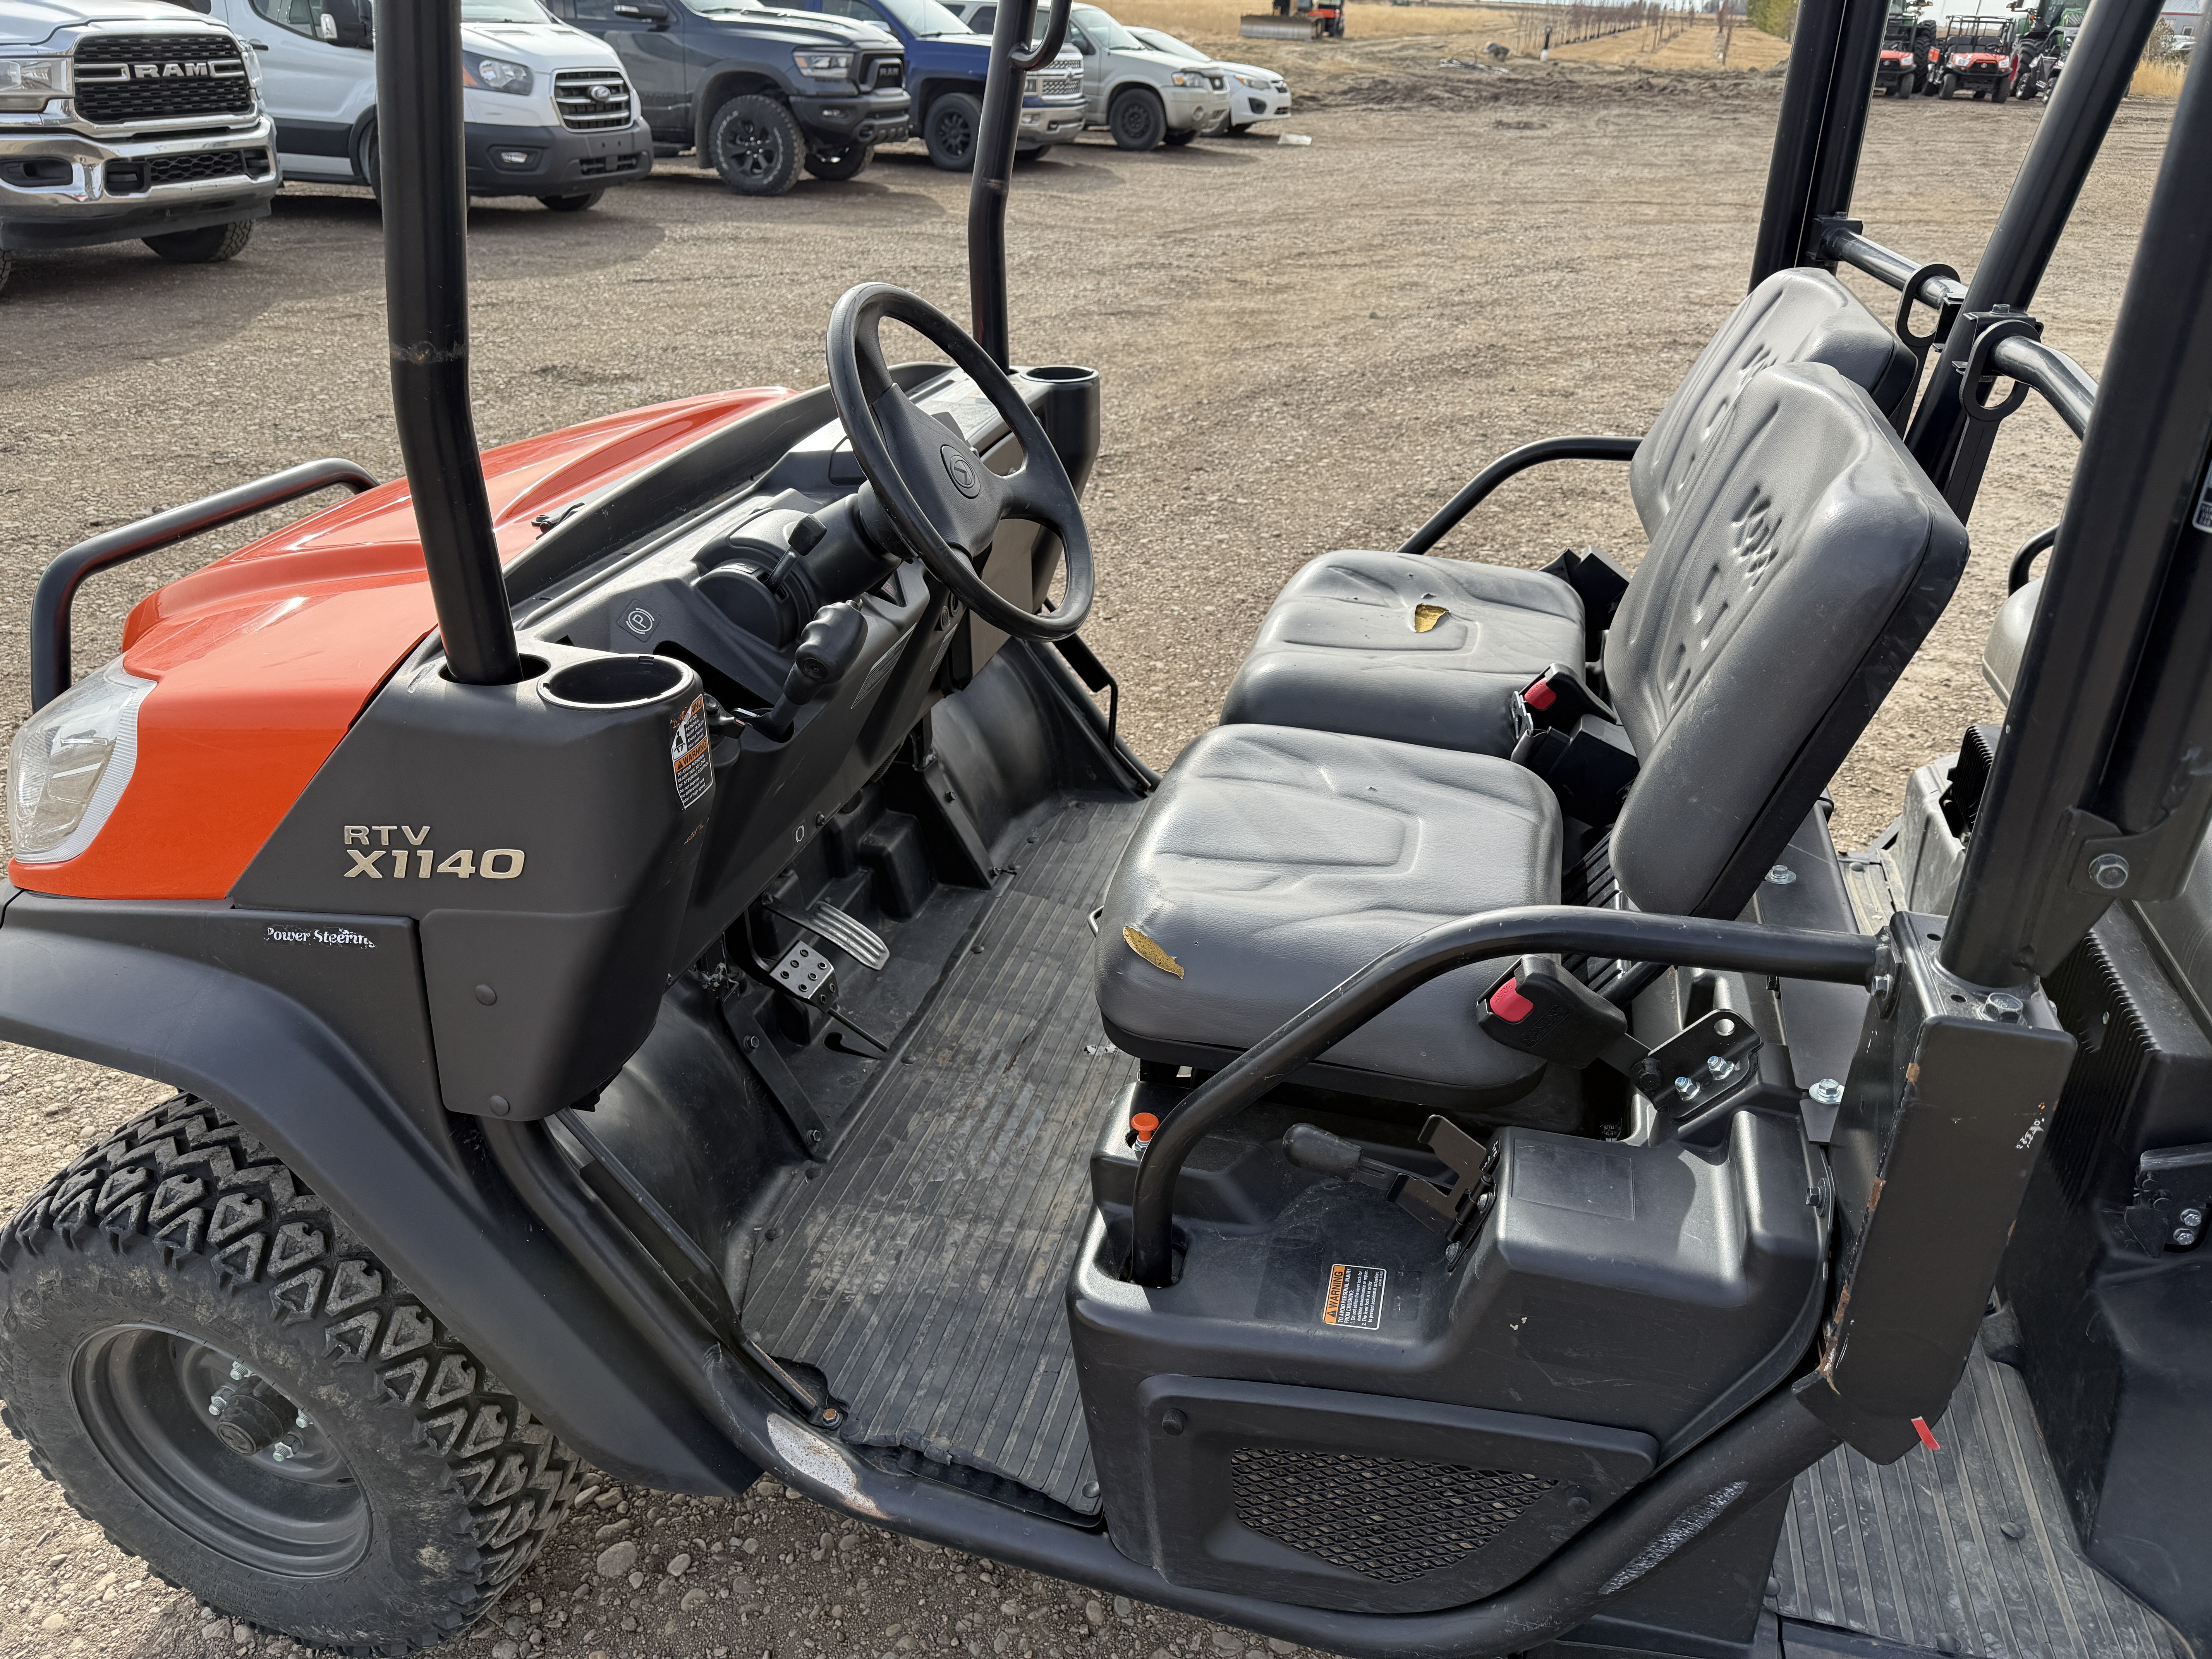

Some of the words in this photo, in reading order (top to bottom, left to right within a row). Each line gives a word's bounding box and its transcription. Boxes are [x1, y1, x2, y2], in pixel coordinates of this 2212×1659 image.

[134, 63, 208, 78] RAM
[692, 699, 701, 712] NING
[683, 741, 707, 765] WARNING
[682, 765, 691, 774] AVOID
[692, 754, 704, 766] PERSONAL
[684, 771, 698, 785] STEERING
[698, 762, 709, 774] CONTROL
[678, 772, 689, 783] INJURY
[344, 825, 431, 845] RTV
[343, 849, 525, 879] X1140
[1493, 982, 1513, 1004] PRESS
[1329, 1271, 1343, 1308] WARNING
[1341, 1283, 1350, 1304] PERSONAL
